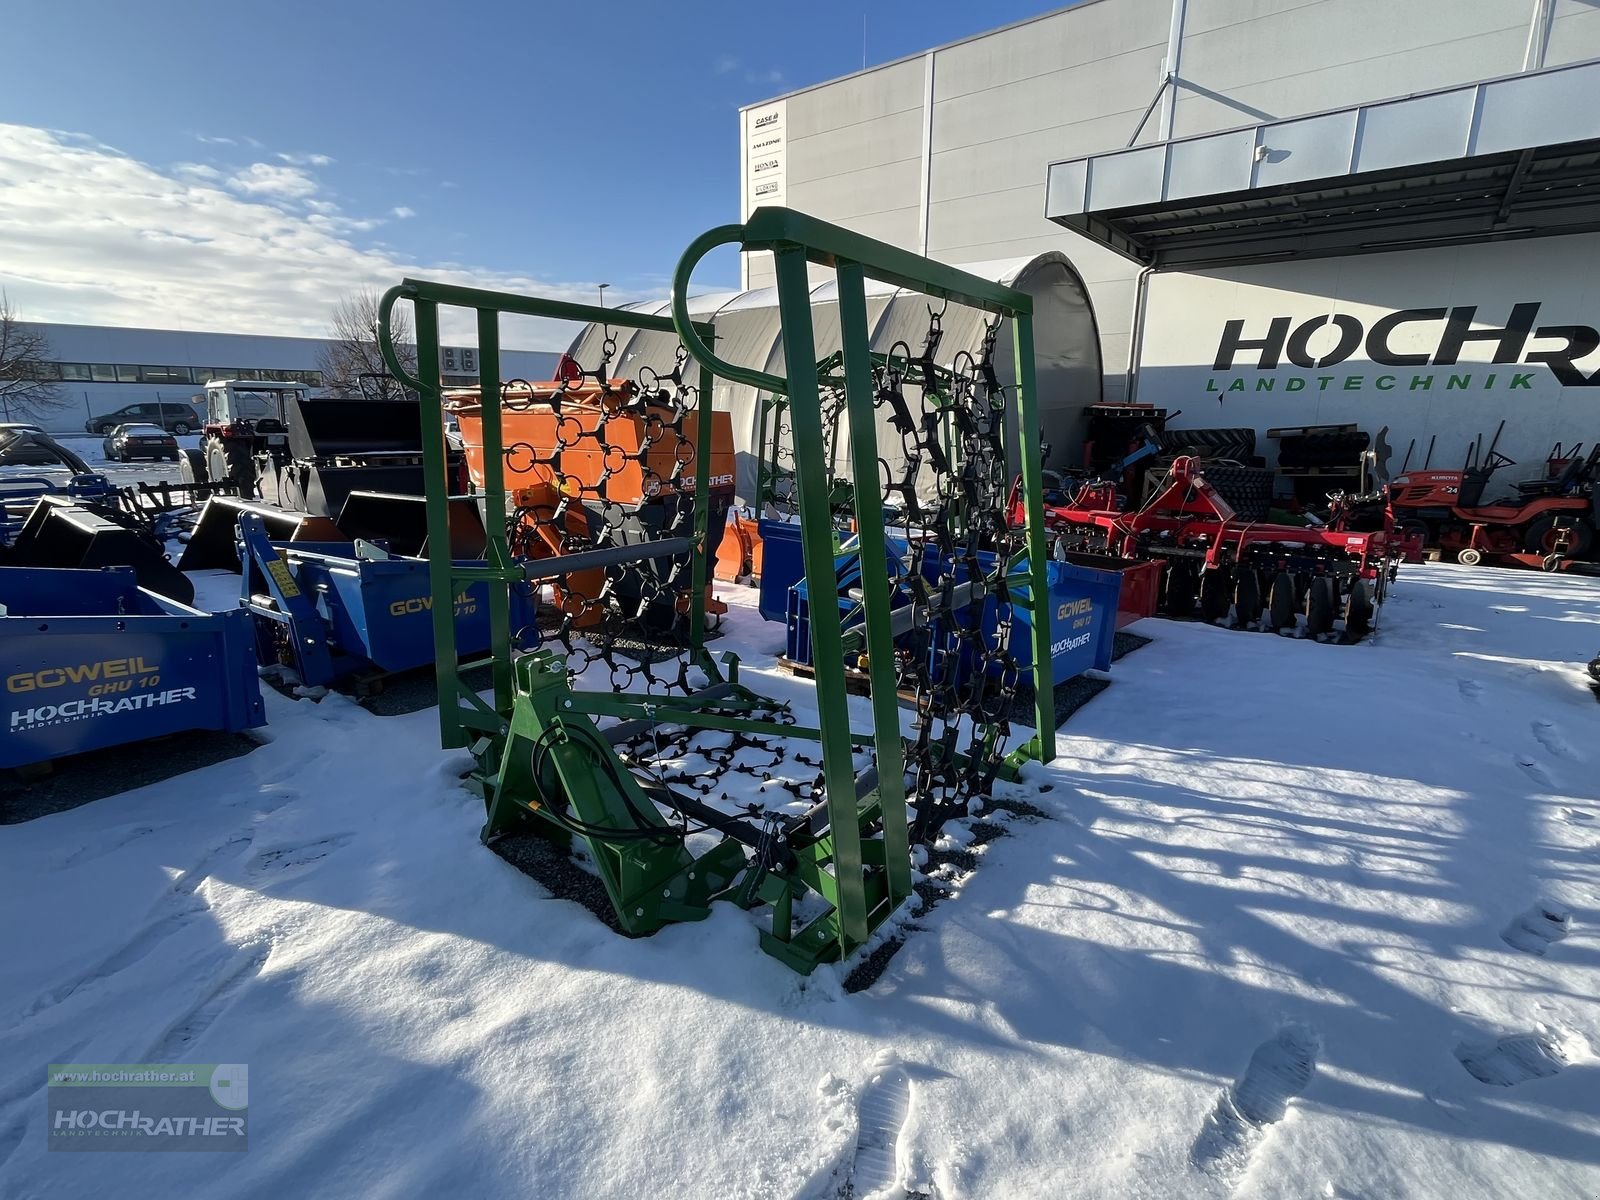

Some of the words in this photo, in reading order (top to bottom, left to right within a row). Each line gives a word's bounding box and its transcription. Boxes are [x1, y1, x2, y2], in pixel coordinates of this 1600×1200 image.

[1213, 302, 1600, 386] HOCHR
[1206, 373, 1537, 392] LANDTECHNIK
[88, 680, 133, 697] GHU
[139, 674, 160, 689] 10
[10, 686, 197, 726] HOCHRATHER
[10, 711, 103, 733] LANDTECHNIK
